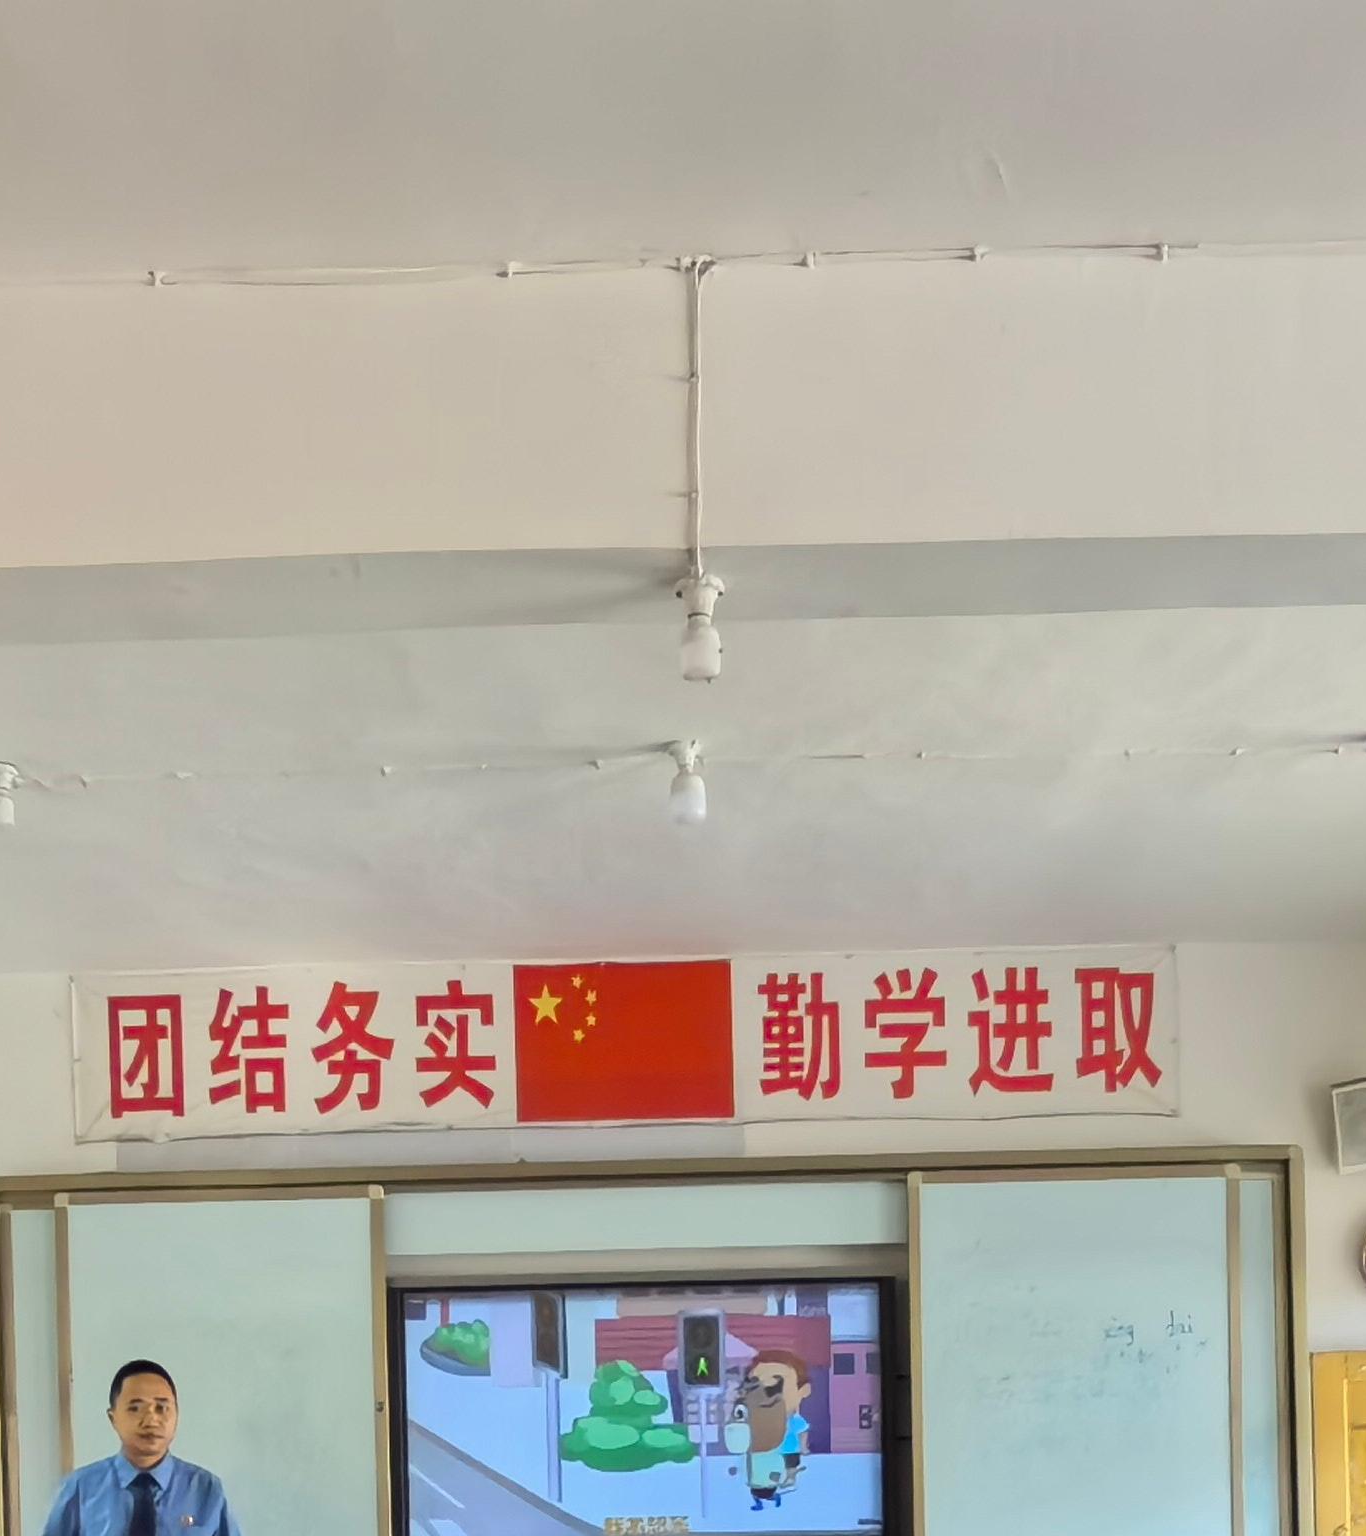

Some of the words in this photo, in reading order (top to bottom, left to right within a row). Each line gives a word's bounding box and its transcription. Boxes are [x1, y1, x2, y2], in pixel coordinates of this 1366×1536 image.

[110, 981, 496, 1117] 团结务实
[759, 969, 1160, 1098] 勤学进取
